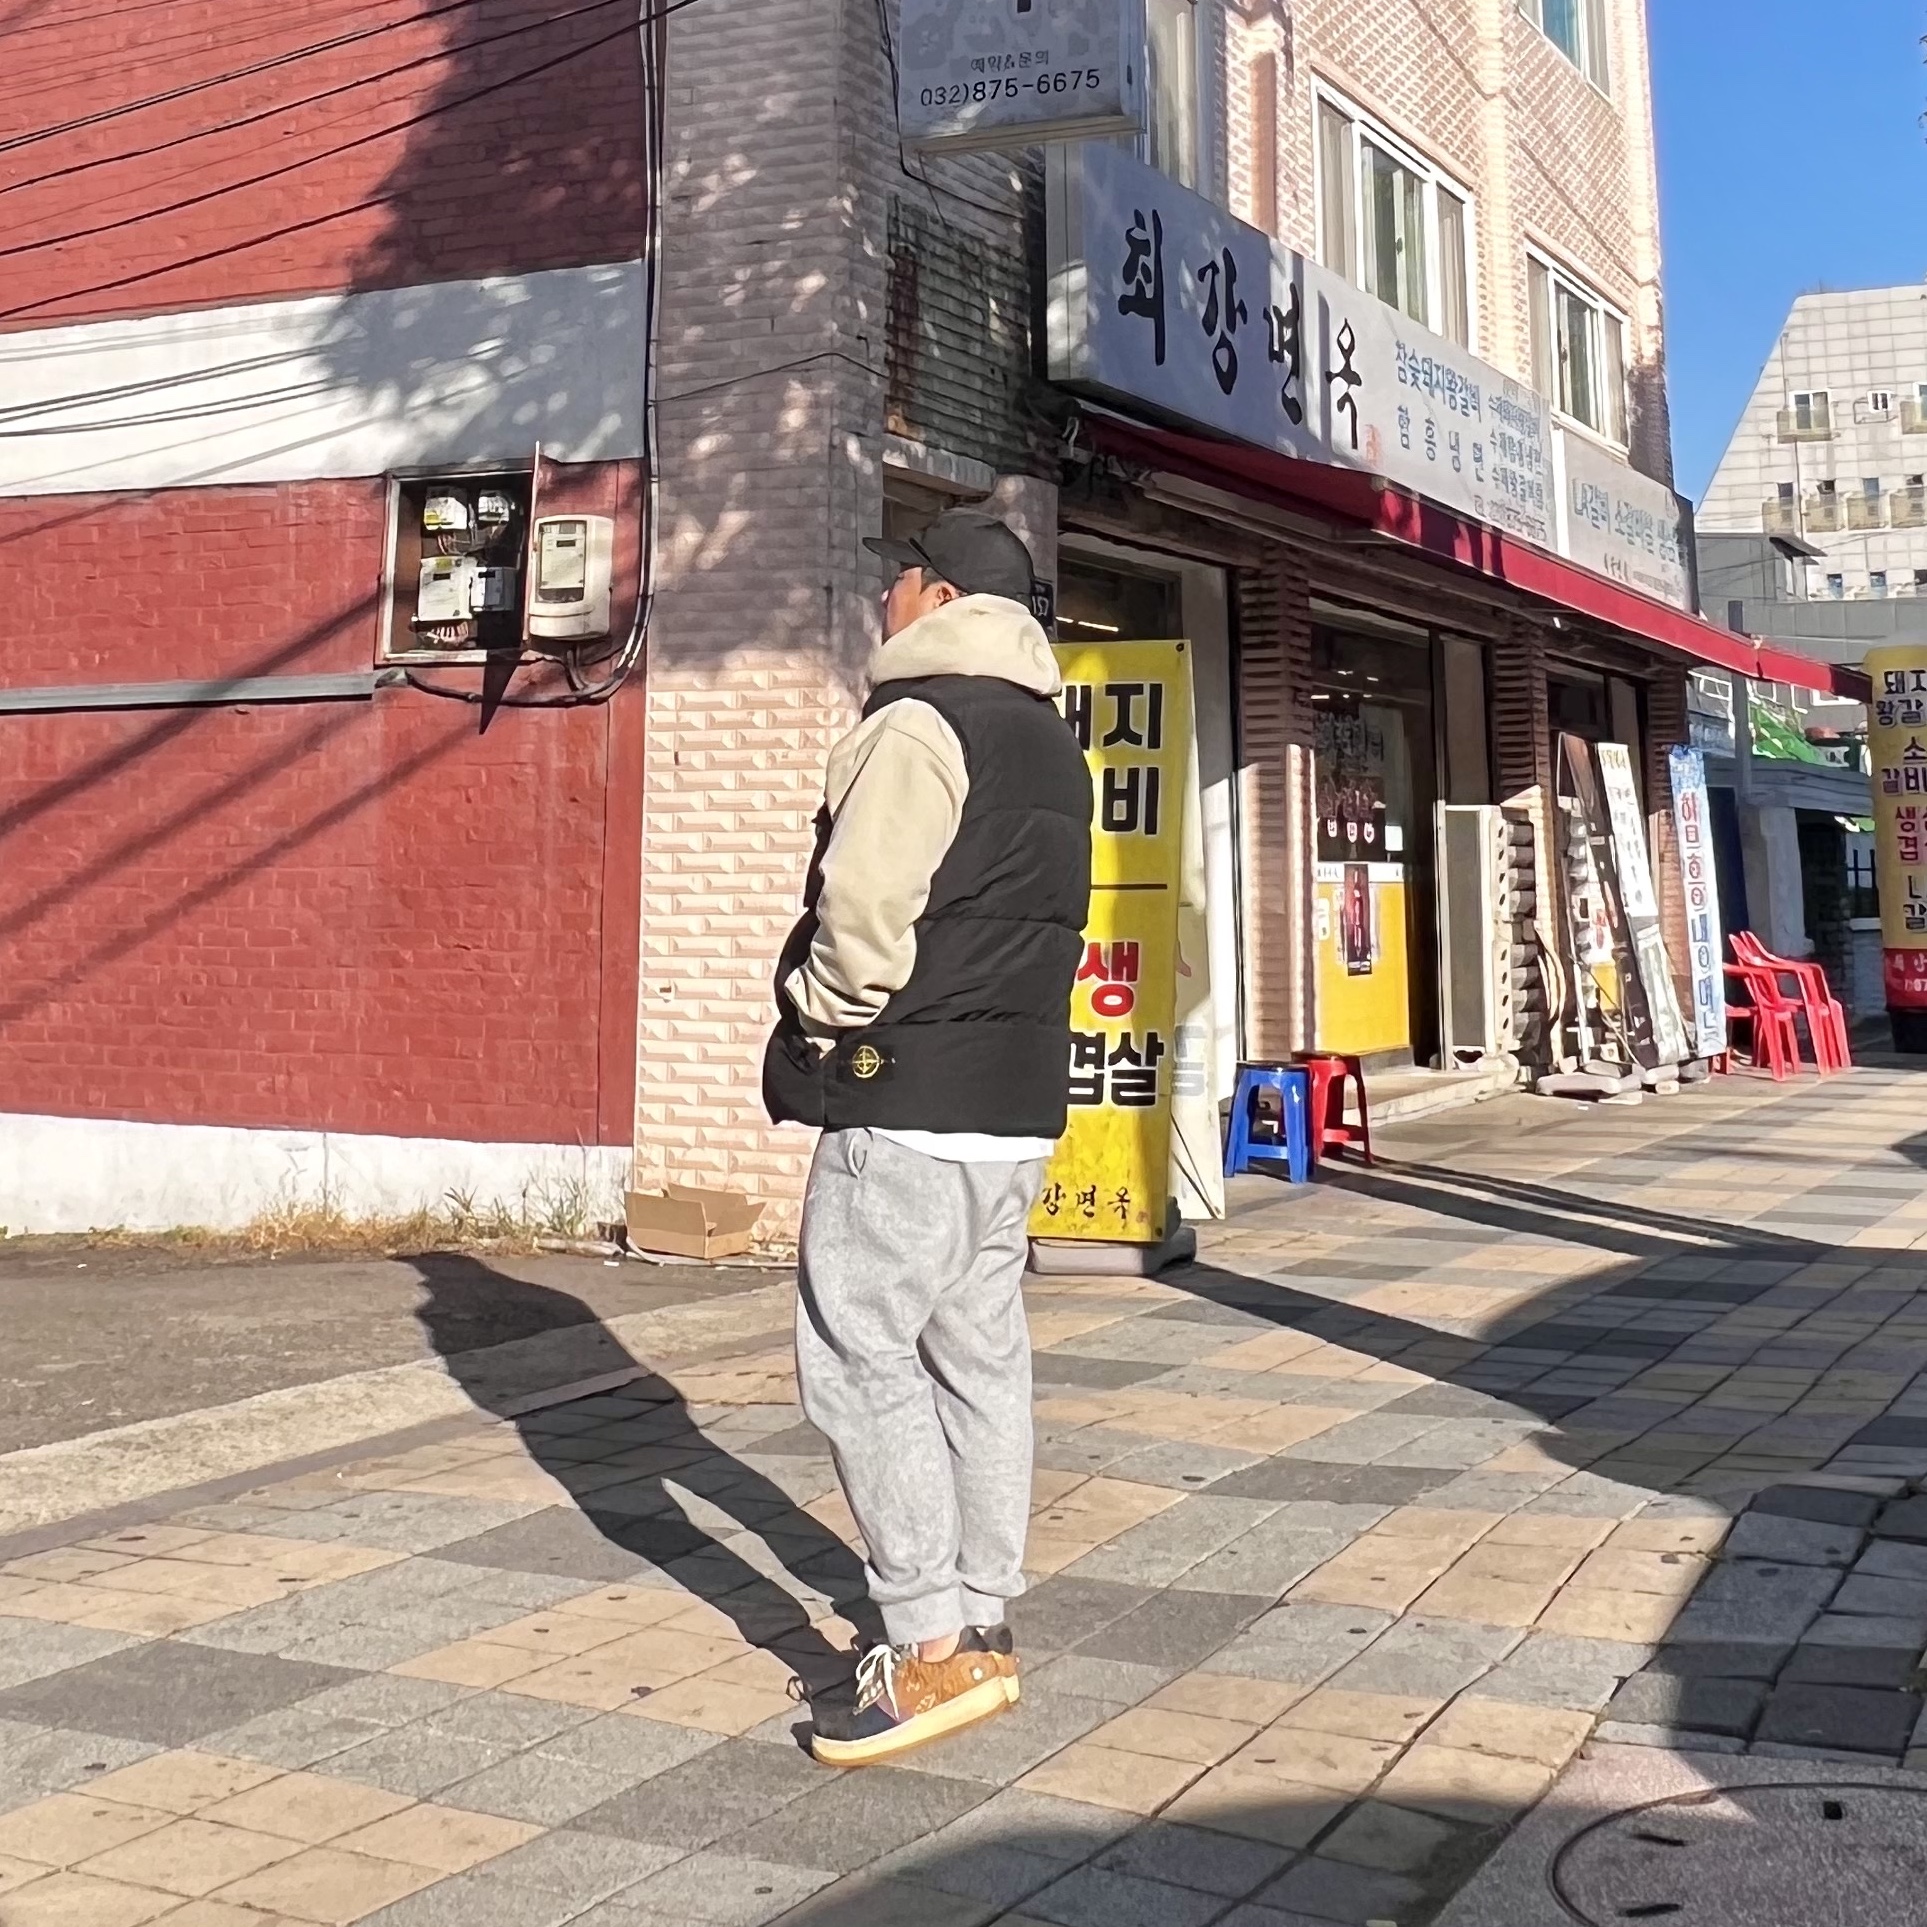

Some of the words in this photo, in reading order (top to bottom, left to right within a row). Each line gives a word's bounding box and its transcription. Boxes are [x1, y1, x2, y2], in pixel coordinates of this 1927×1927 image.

[920, 68, 1101, 107] 032)875-6675
[1117, 208, 1362, 450] 최강면옥
[1895, 806, 1927, 833] 생
[1077, 941, 1139, 1017] 생
